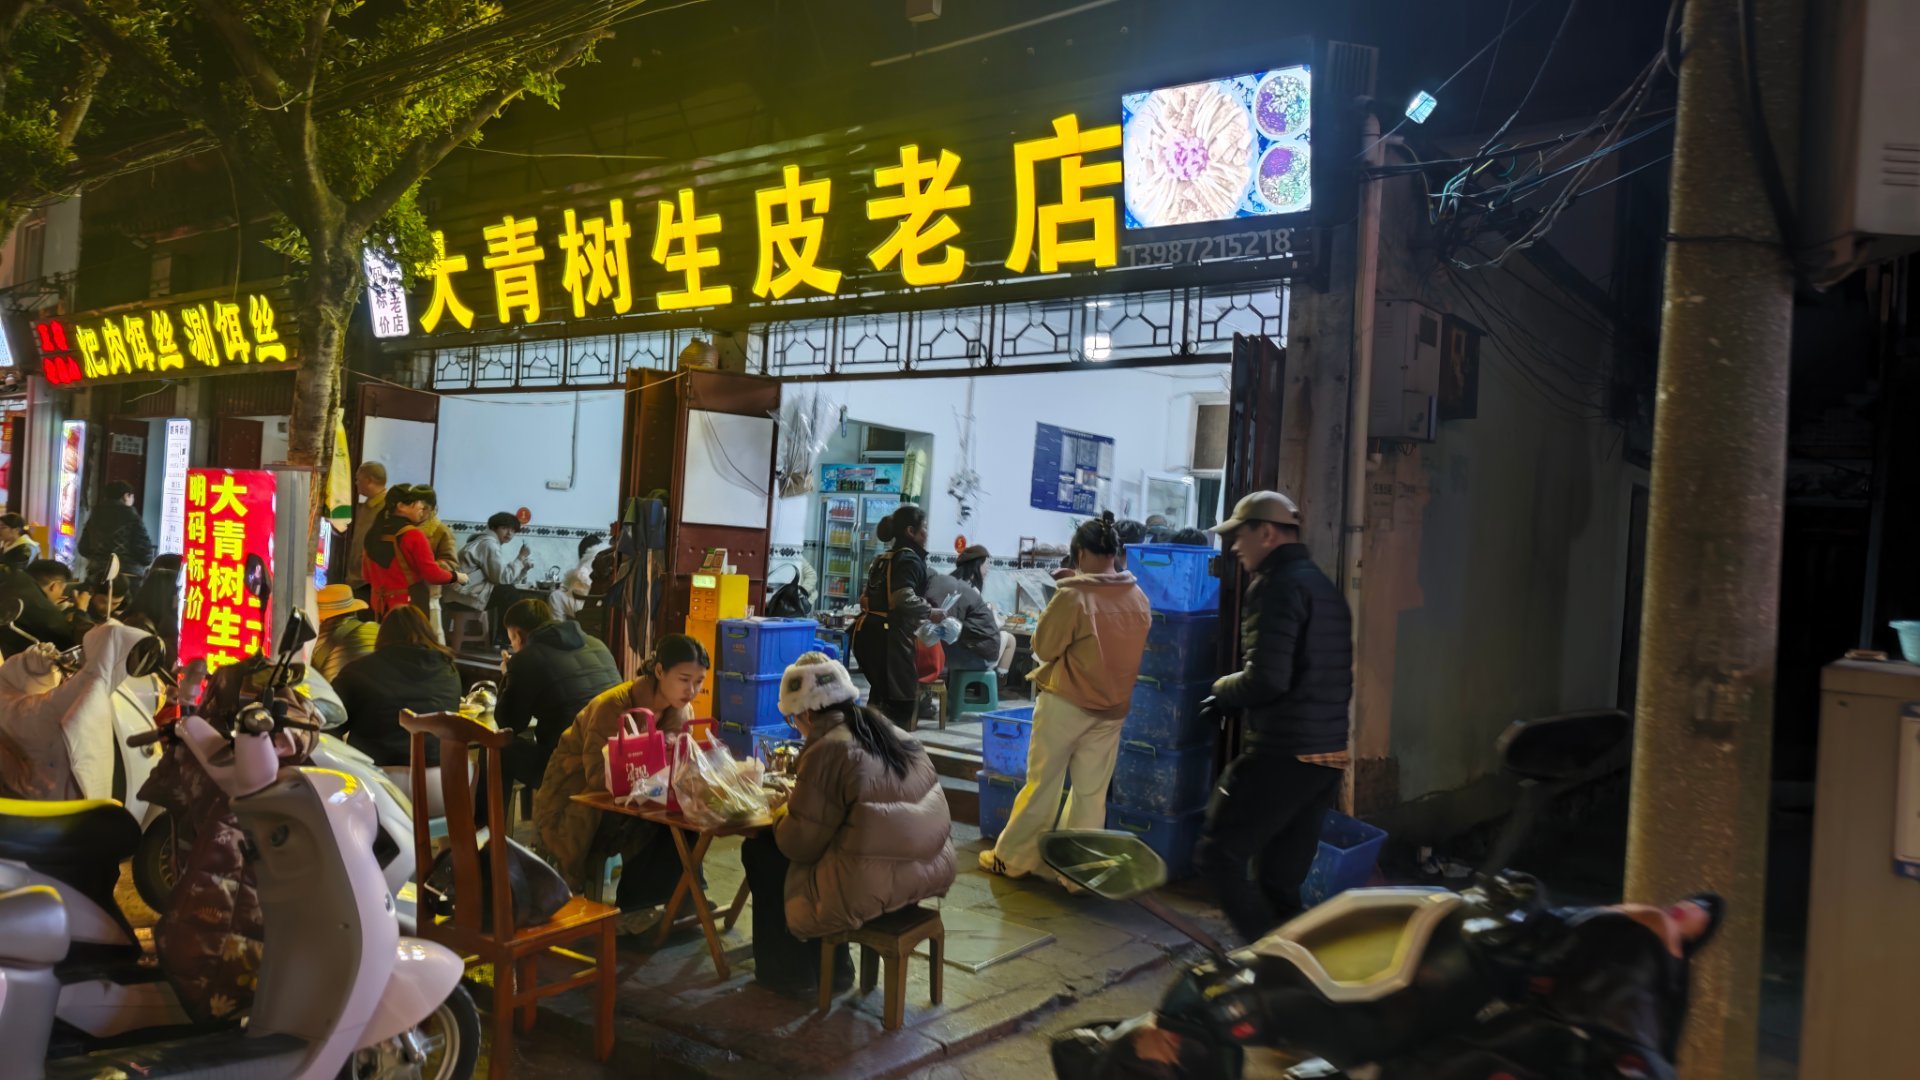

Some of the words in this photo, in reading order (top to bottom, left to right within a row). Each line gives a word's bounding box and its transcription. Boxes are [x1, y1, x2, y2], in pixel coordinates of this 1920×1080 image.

[415, 113, 1122, 333] 大青树生皮老店
[1121, 227, 1291, 267] 13987215218
[186, 474, 207, 621] 明码标价
